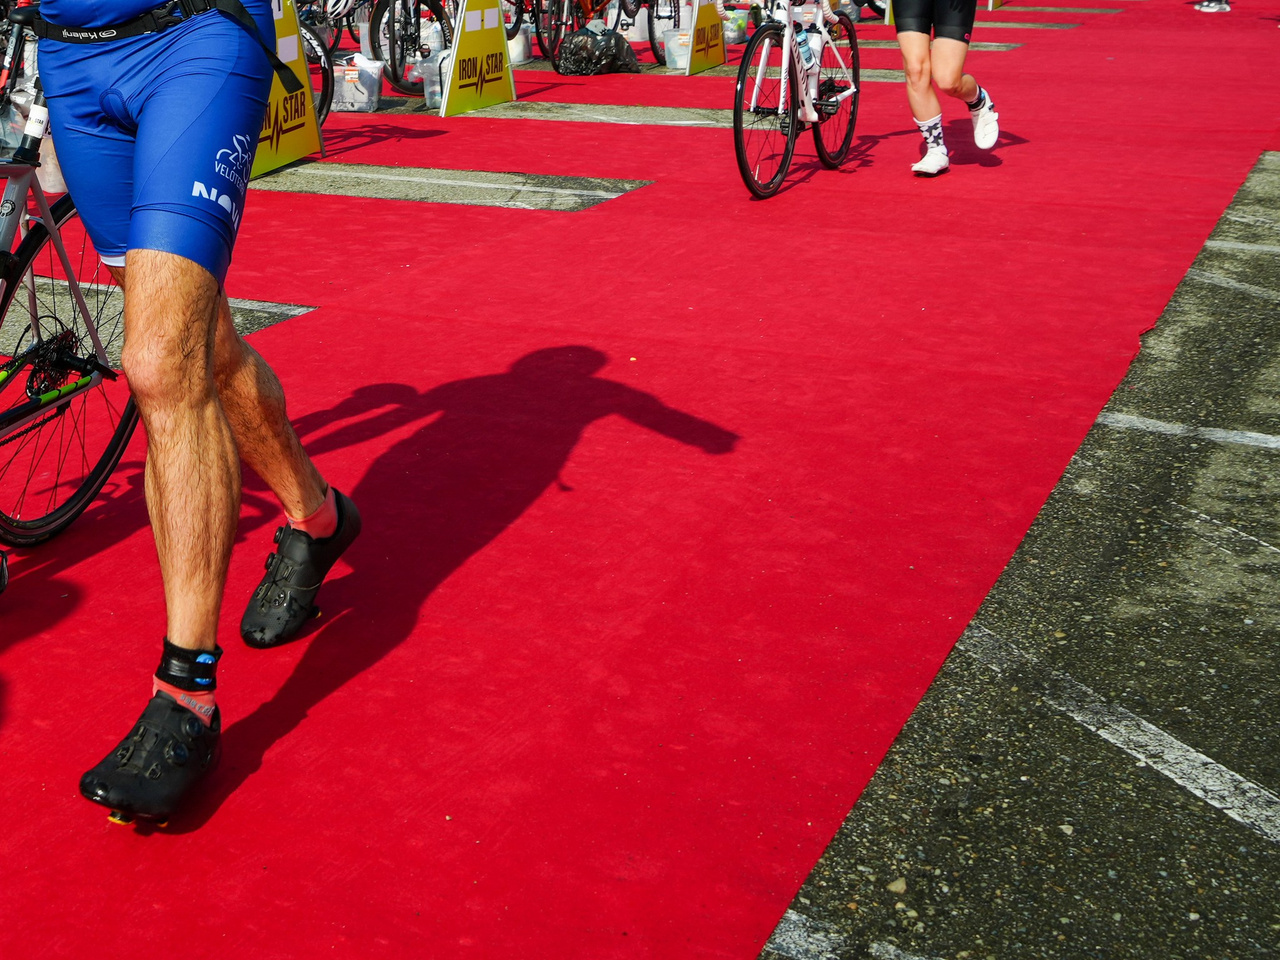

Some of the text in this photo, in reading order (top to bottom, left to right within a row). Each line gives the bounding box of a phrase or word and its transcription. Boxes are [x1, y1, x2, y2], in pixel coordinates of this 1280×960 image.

[458, 51, 504, 81] IRON STAR
[282, 90, 306, 124] STAR
